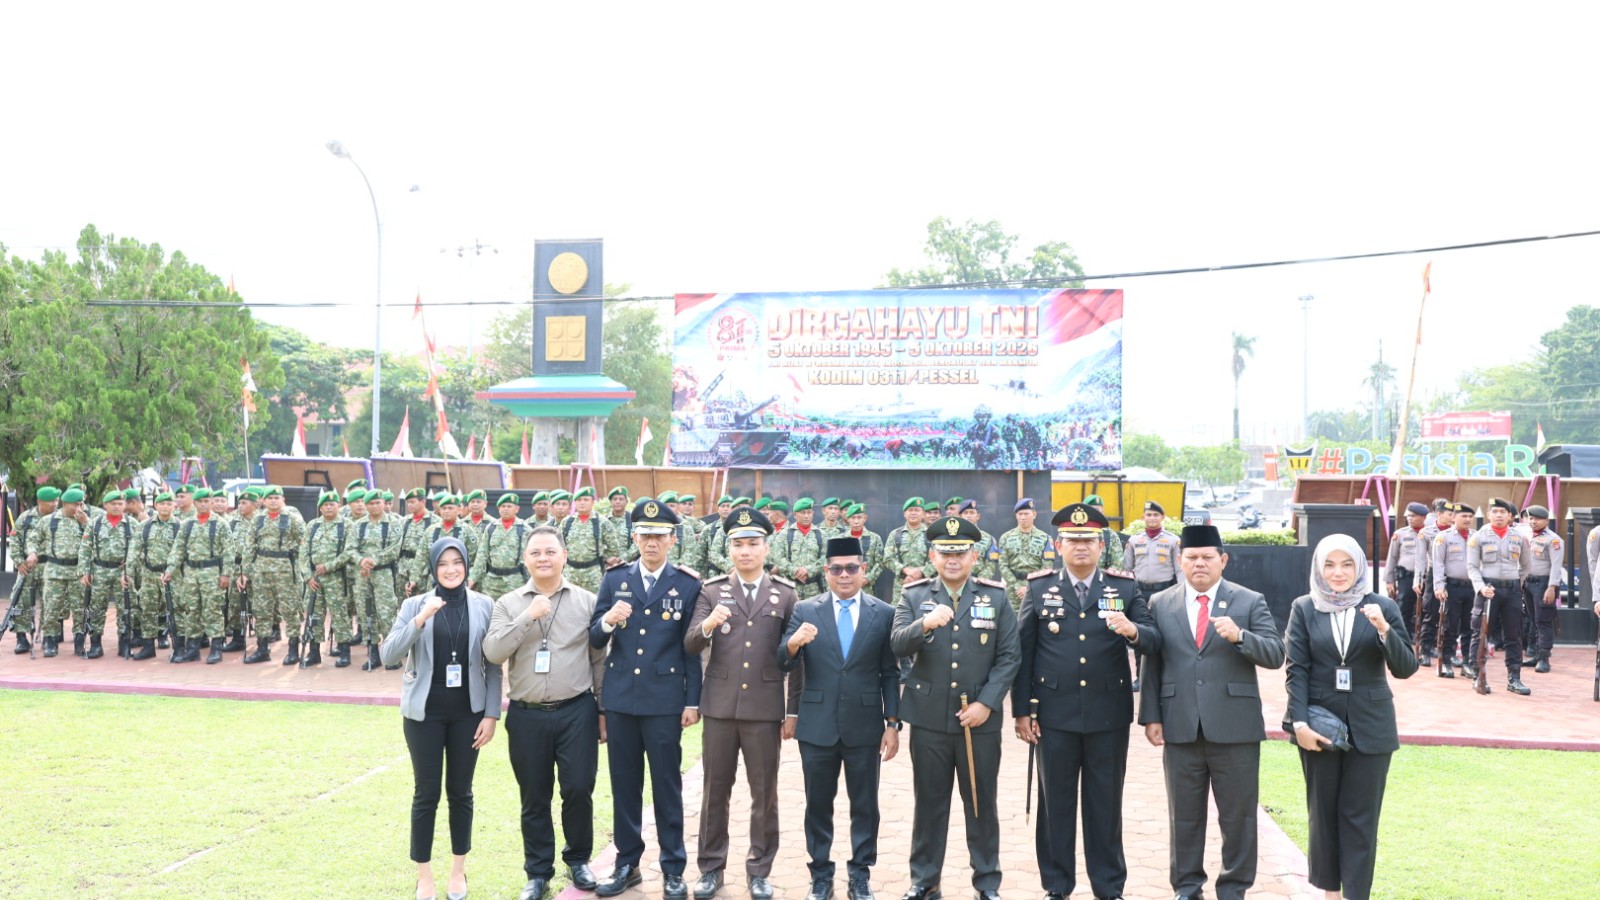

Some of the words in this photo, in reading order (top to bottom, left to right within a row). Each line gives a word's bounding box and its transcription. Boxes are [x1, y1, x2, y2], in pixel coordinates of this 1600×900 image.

[768, 306, 969, 341] DIRGAHAYU
[981, 305, 1039, 339] TNI
[768, 343, 781, 358] 5
[784, 343, 850, 358] OKTOBER
[854, 342, 892, 357] 1945
[908, 342, 921, 357] 5
[924, 341, 993, 356] OKTOBER
[808, 369, 864, 386] KODIM
[867, 368, 979, 385] 0311/PESSEL
